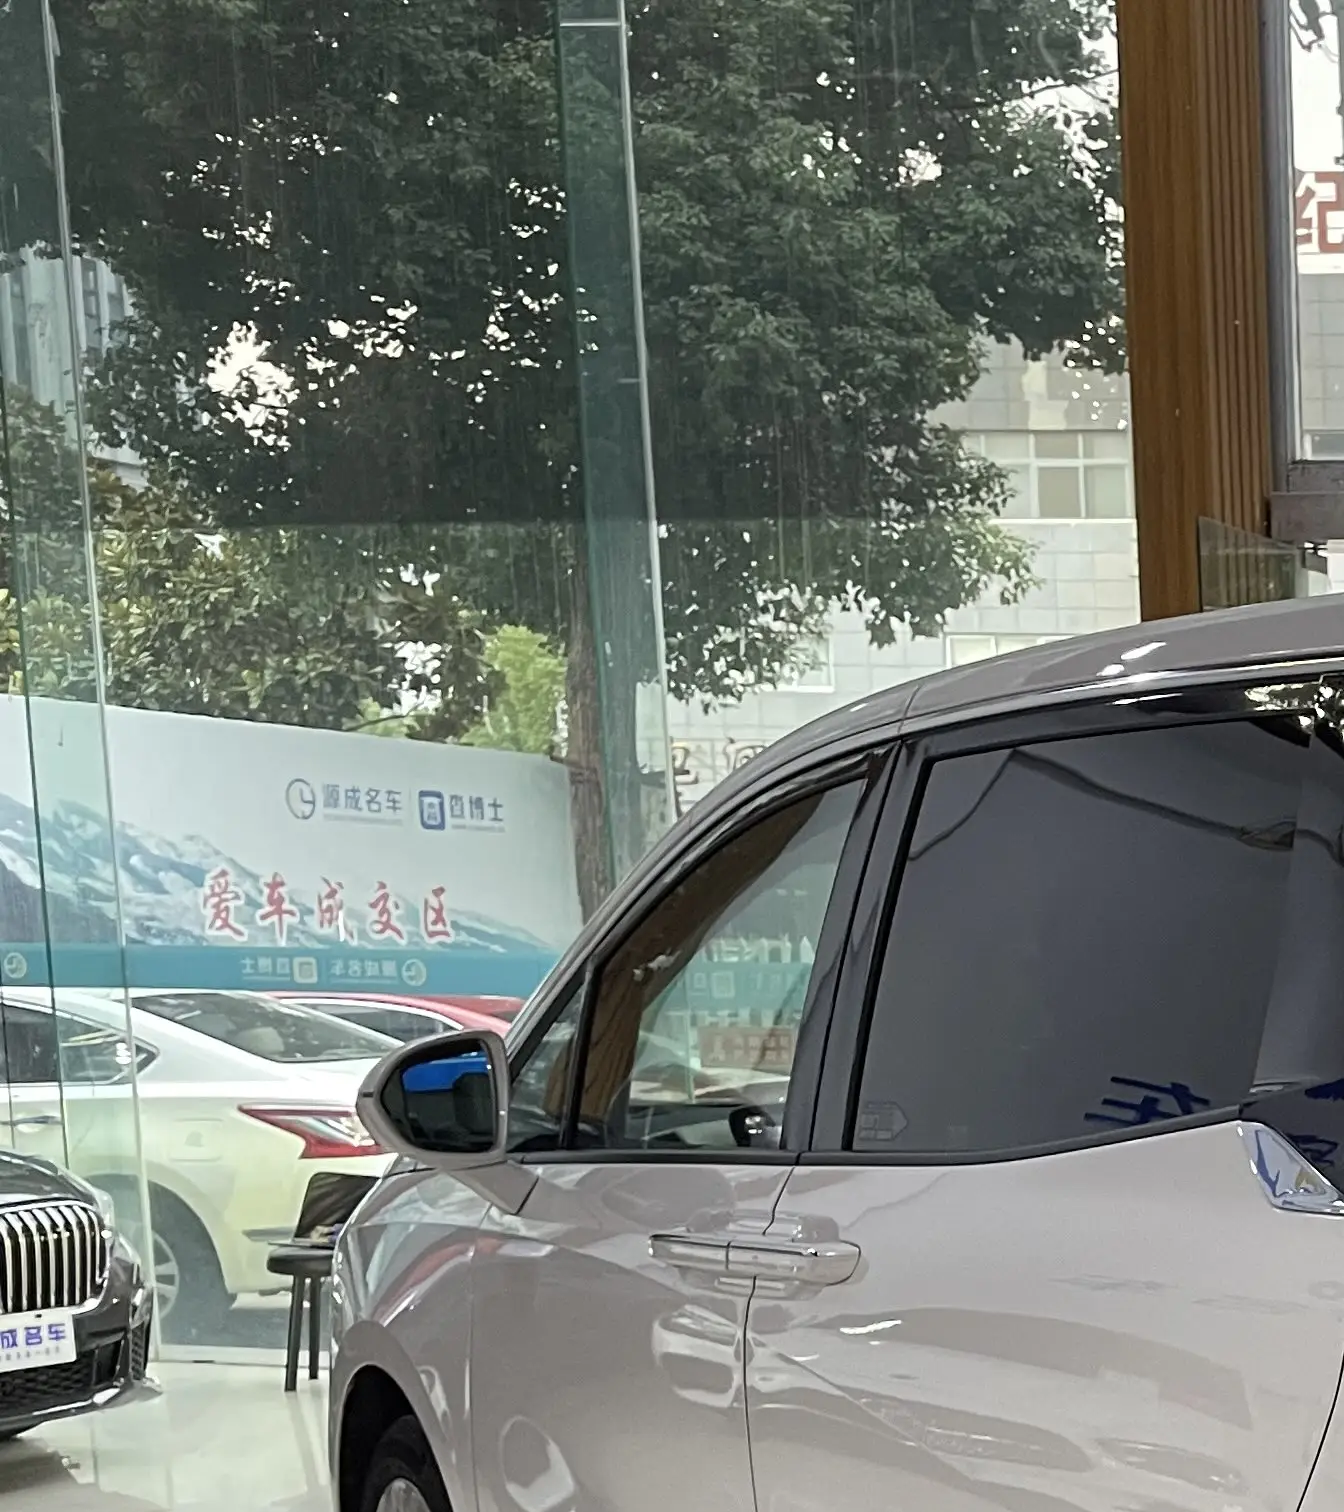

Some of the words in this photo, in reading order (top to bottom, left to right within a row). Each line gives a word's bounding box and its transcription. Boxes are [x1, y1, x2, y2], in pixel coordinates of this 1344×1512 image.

[202, 867, 451, 945] 爱车成交区
